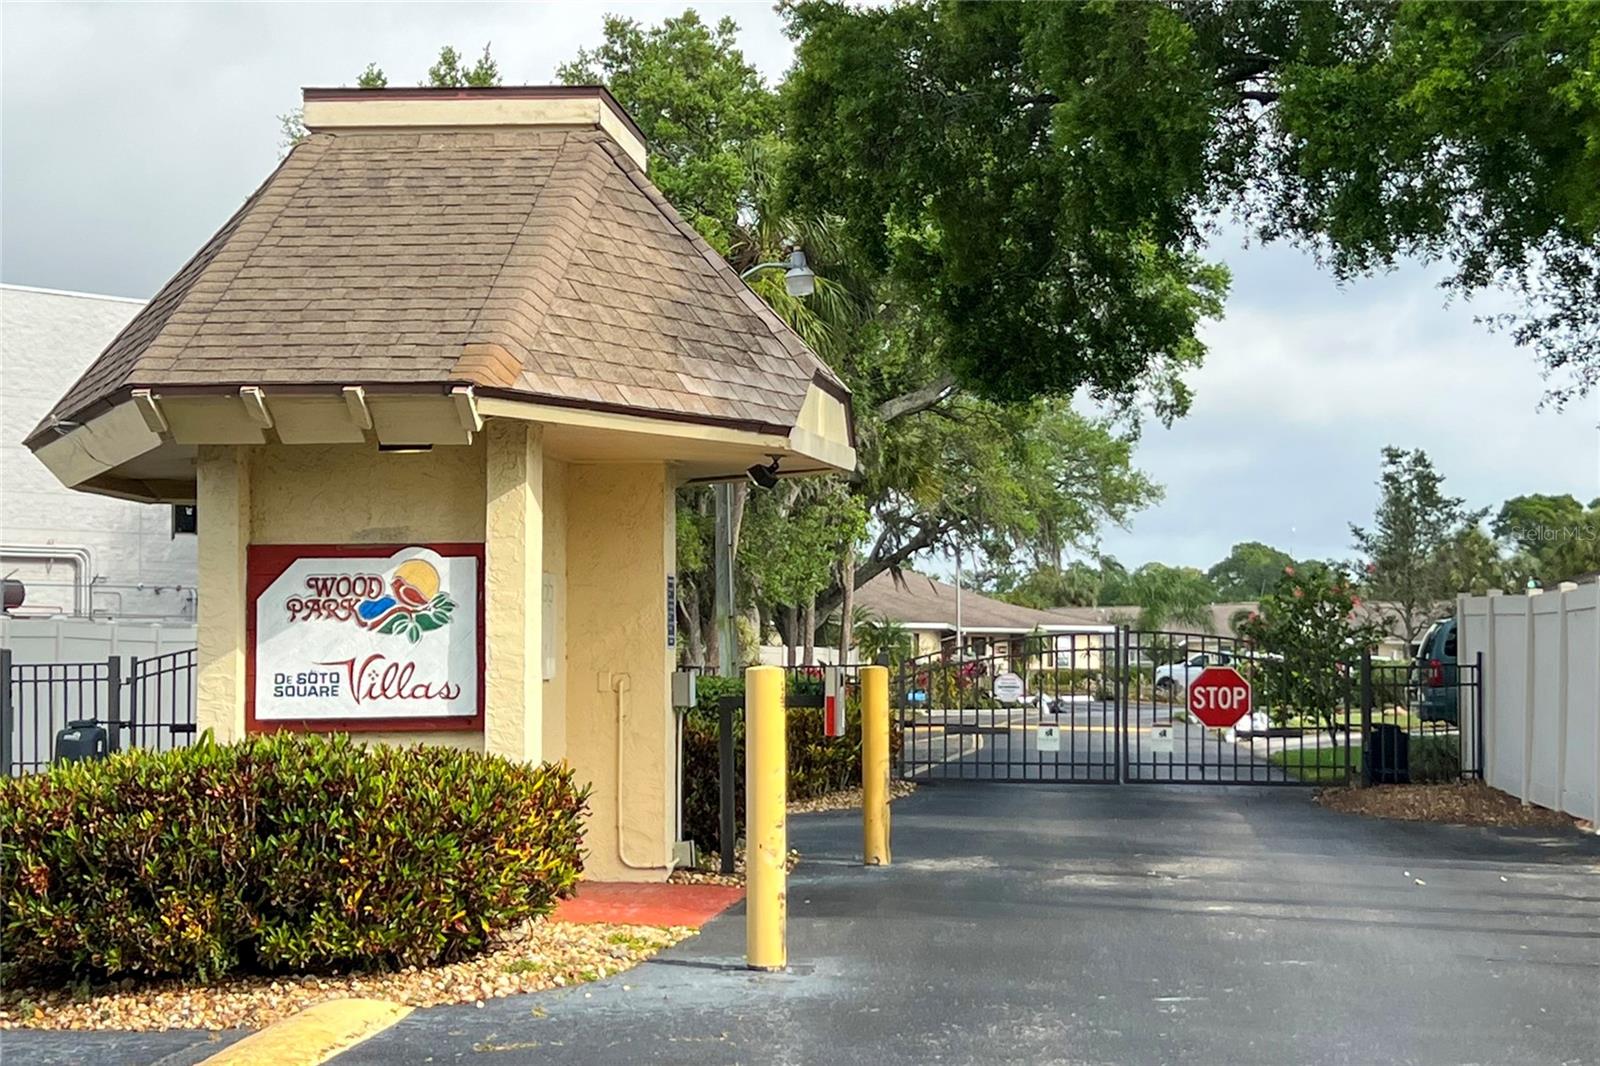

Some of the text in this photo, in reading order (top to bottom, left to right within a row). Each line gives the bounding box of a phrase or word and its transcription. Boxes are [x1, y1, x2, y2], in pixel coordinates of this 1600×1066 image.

[306, 574, 385, 599] WOOD
[286, 596, 367, 627] PARK
[296, 671, 340, 685] SOTO
[312, 653, 461, 705] Villas
[273, 685, 339, 697] SQUARE
[1192, 686, 1247, 709] STOP
